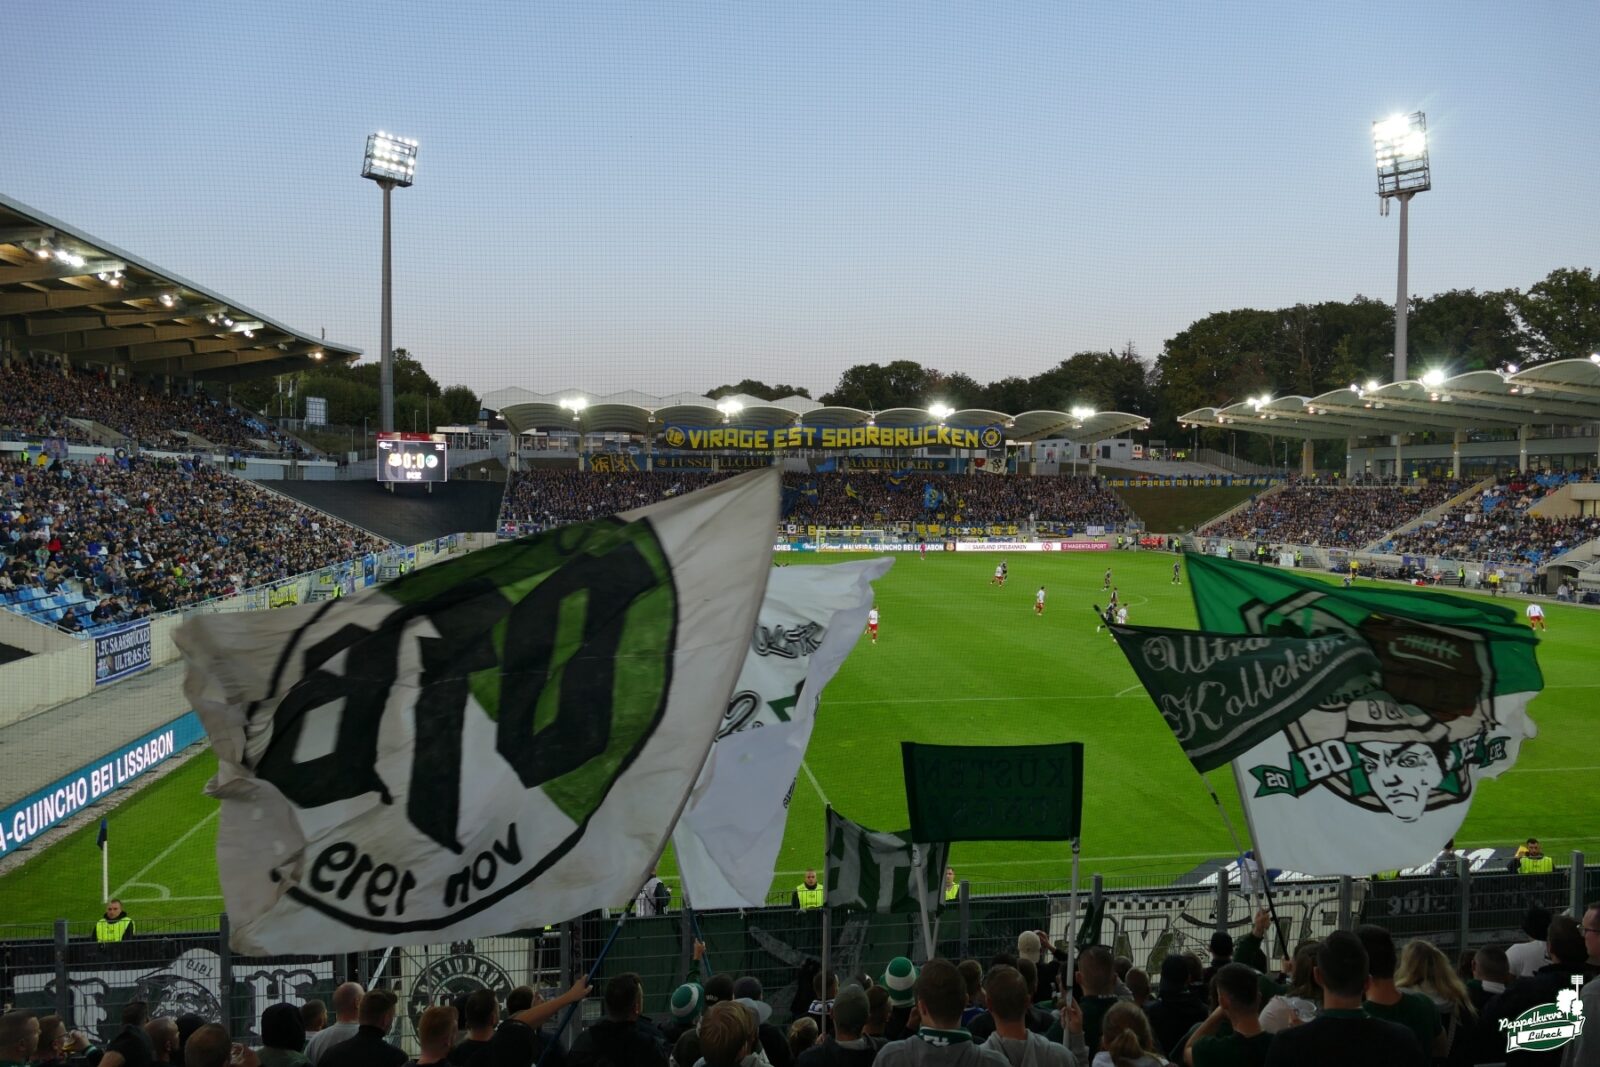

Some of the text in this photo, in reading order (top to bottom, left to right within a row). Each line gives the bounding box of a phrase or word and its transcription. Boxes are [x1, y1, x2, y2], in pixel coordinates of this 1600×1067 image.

[688, 428, 769, 449] VIRAGE
[773, 427, 817, 448] EST
[671, 456, 769, 468] FUSSBLLCLUB
[114, 647, 141, 671] ULTRAS
[91, 762, 114, 798] BEI
[117, 730, 174, 784] LISSABON
[1264, 771, 1289, 789] 20
